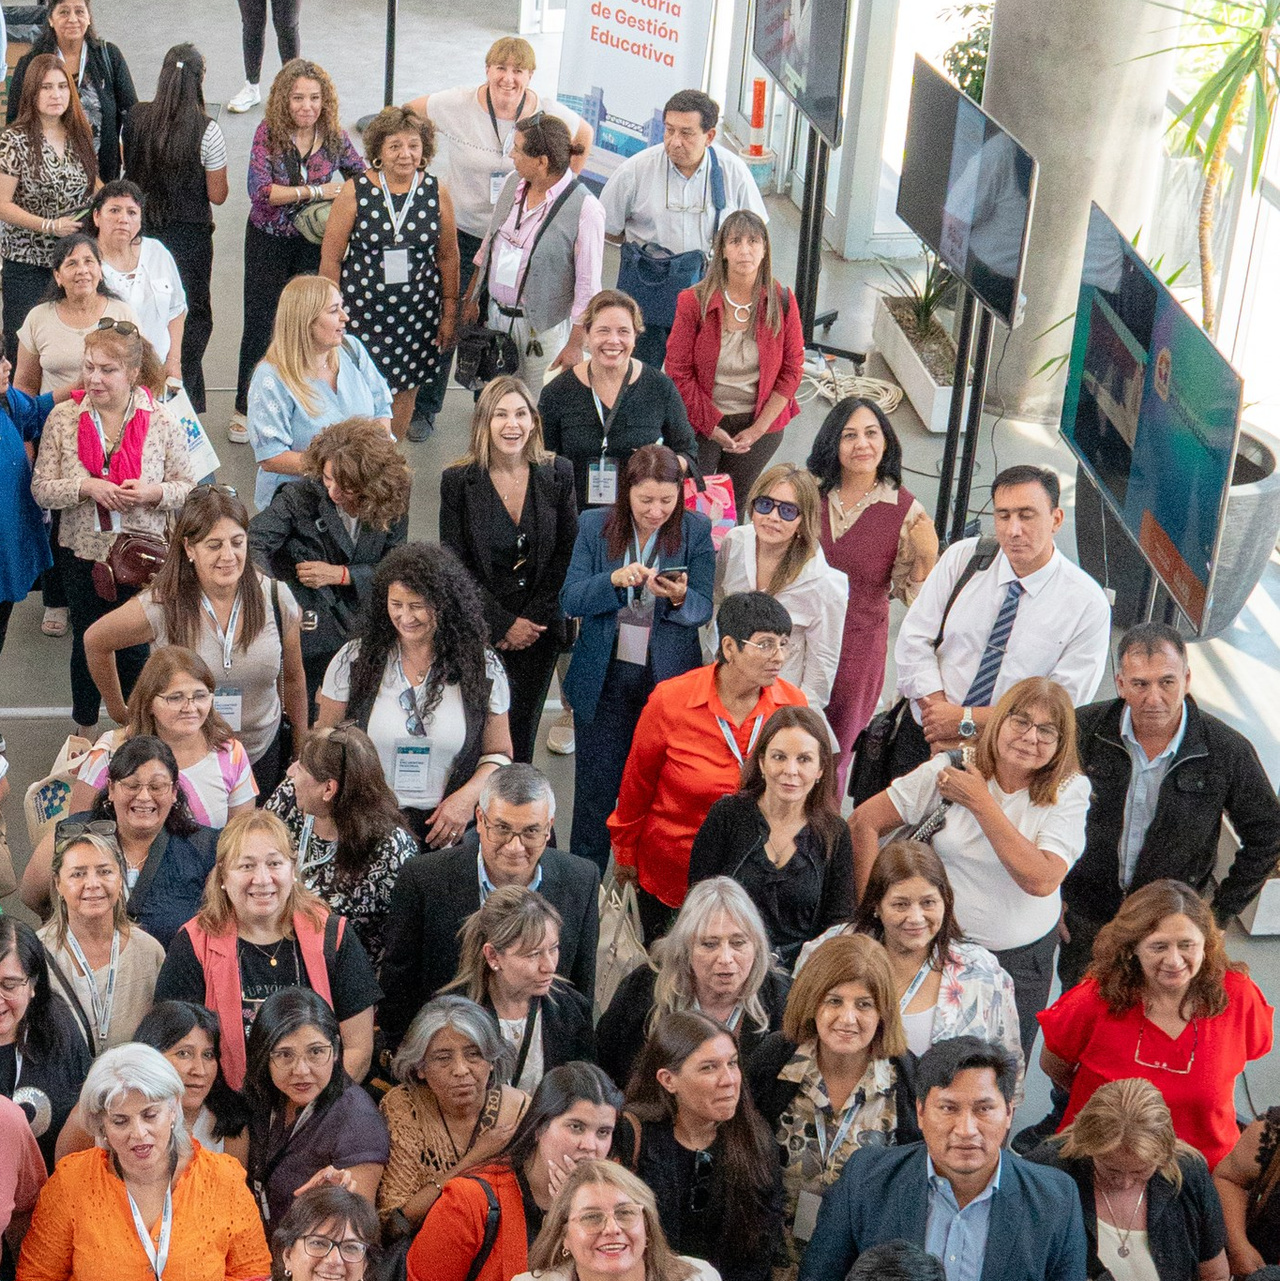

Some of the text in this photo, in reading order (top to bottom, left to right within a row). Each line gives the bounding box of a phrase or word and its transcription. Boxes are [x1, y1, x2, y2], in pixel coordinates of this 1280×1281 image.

[590, 1, 679, 43] de Gestión
[590, 25, 675, 68] Educativa
